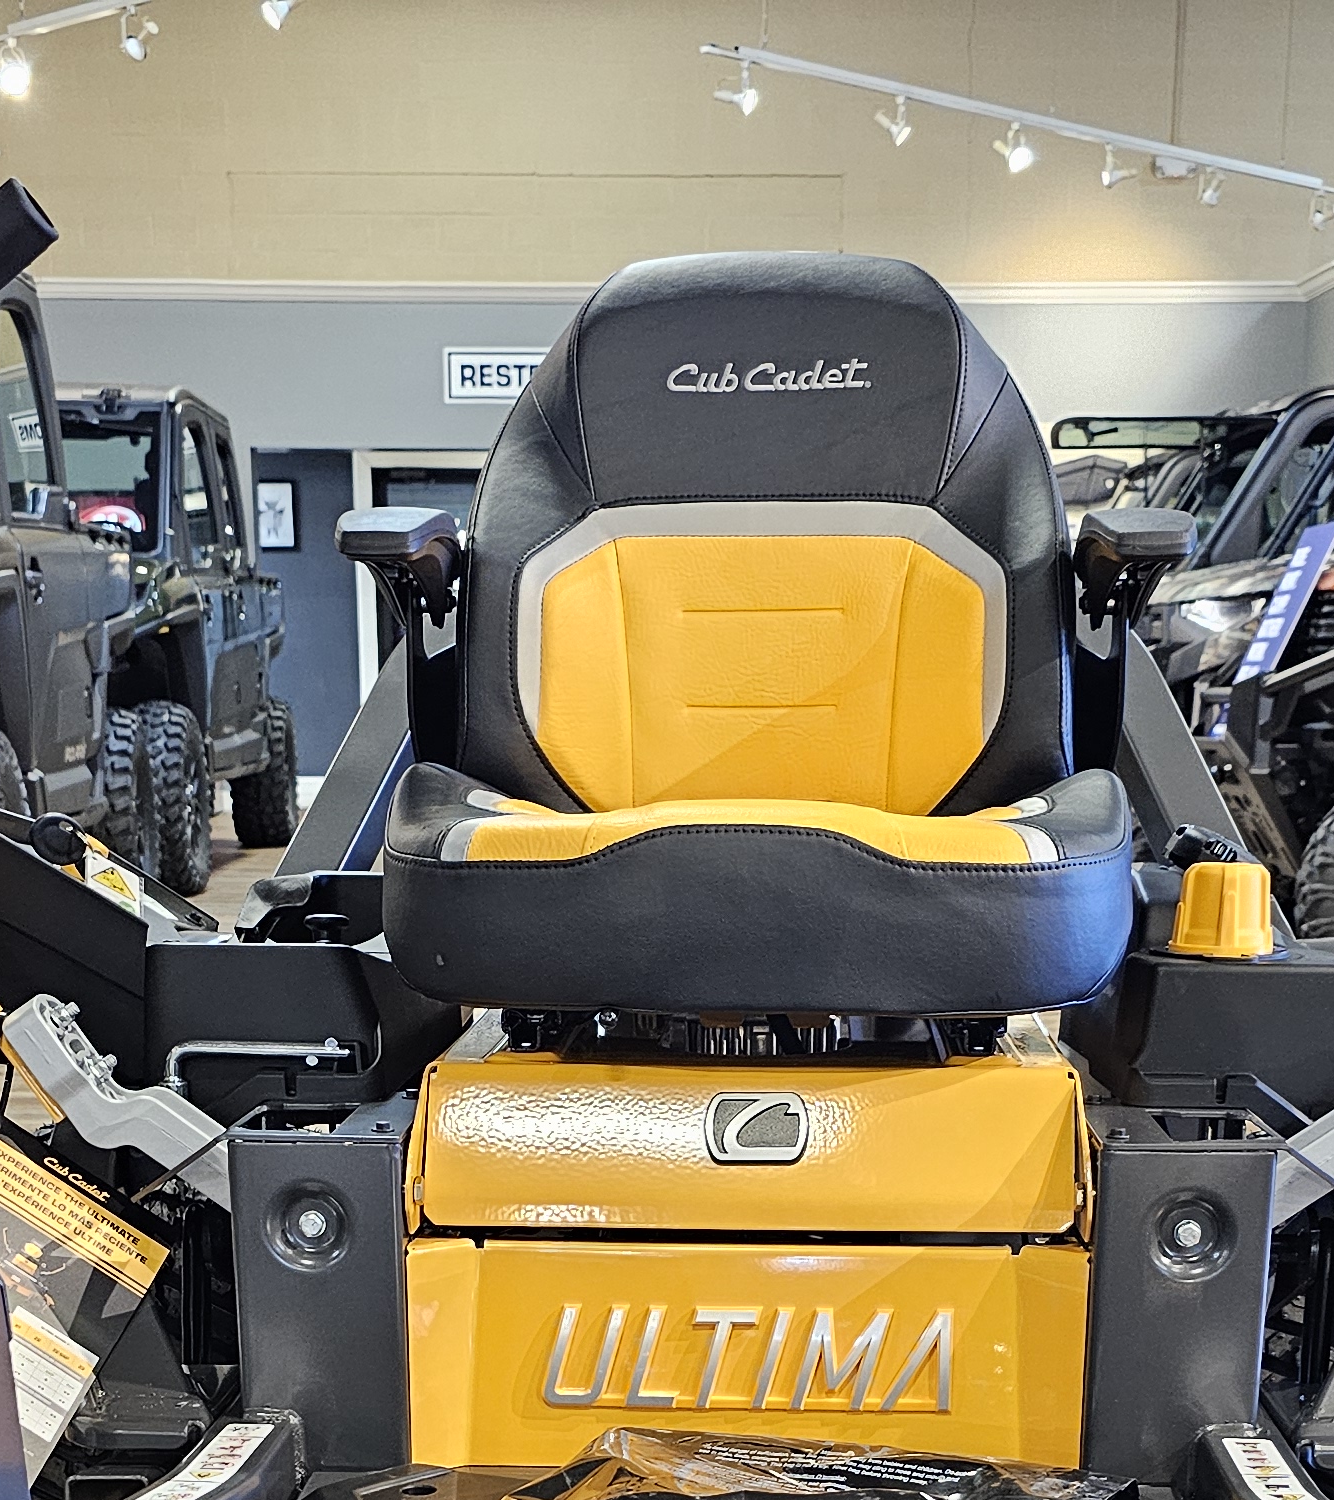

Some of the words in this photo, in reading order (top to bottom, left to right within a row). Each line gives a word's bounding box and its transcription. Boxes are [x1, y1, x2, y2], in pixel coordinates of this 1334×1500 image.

[667, 363, 739, 392] Cub
[43, 1156, 69, 1176] Cub
[51, 1198, 67, 1213] LO
[68, 1208, 94, 1230] MÁS
[95, 1226, 148, 1265] RECIENTE
[64, 1192, 86, 1209] THE
[87, 1207, 141, 1246] ULTIMATE
[73, 1226, 114, 1257] ULTIME
[543, 1303, 954, 1412] ULTIMA
